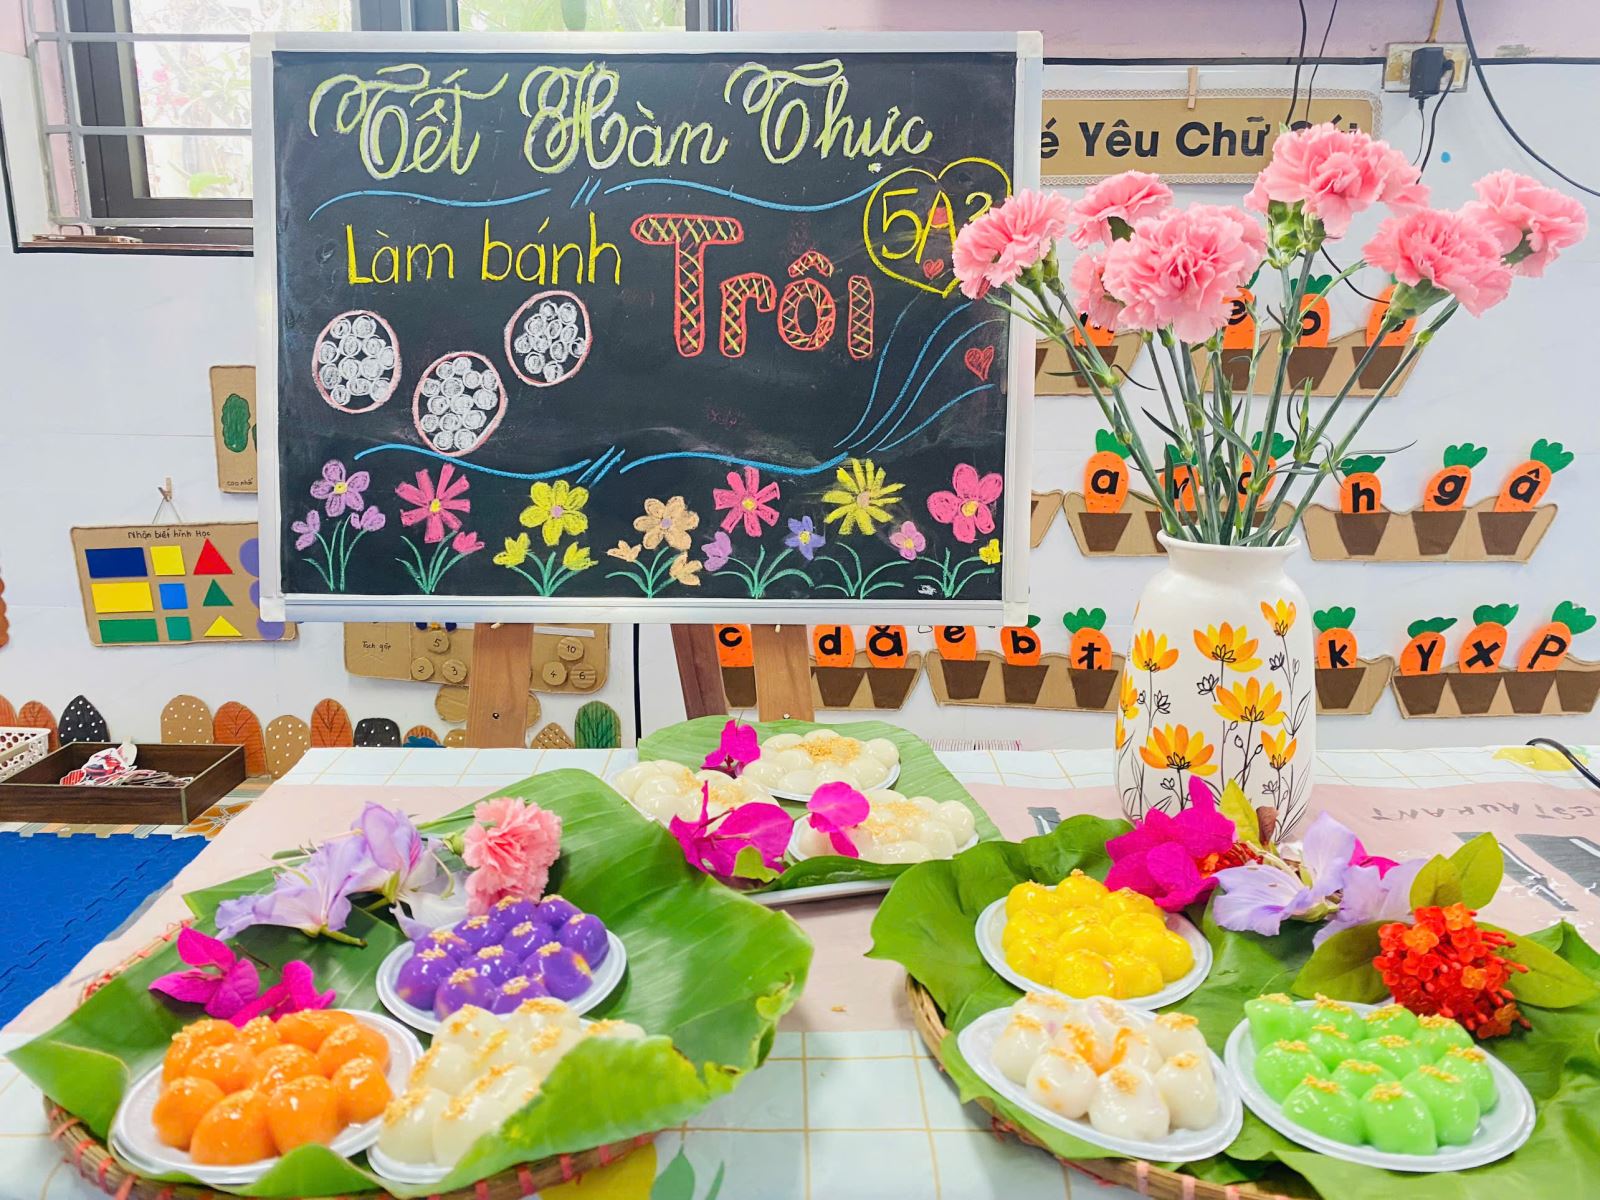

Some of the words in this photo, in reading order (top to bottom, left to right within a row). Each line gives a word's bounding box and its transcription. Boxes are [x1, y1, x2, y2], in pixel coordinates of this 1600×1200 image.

[308, 62, 510, 181] Tết
[519, 61, 730, 175] Hàn
[723, 58, 935, 174] Thực
[1079, 119, 1160, 158] Yêu
[1175, 116, 1271, 157] Chữ
[346, 224, 455, 285] Làm
[481, 211, 622, 286] bánh
[1091, 468, 1120, 495] a
[1351, 481, 1375, 513] h
[1433, 474, 1467, 506] g
[1509, 467, 1541, 503] â
[566, 645, 577, 654] 10
[1010, 630, 1037, 655] b
